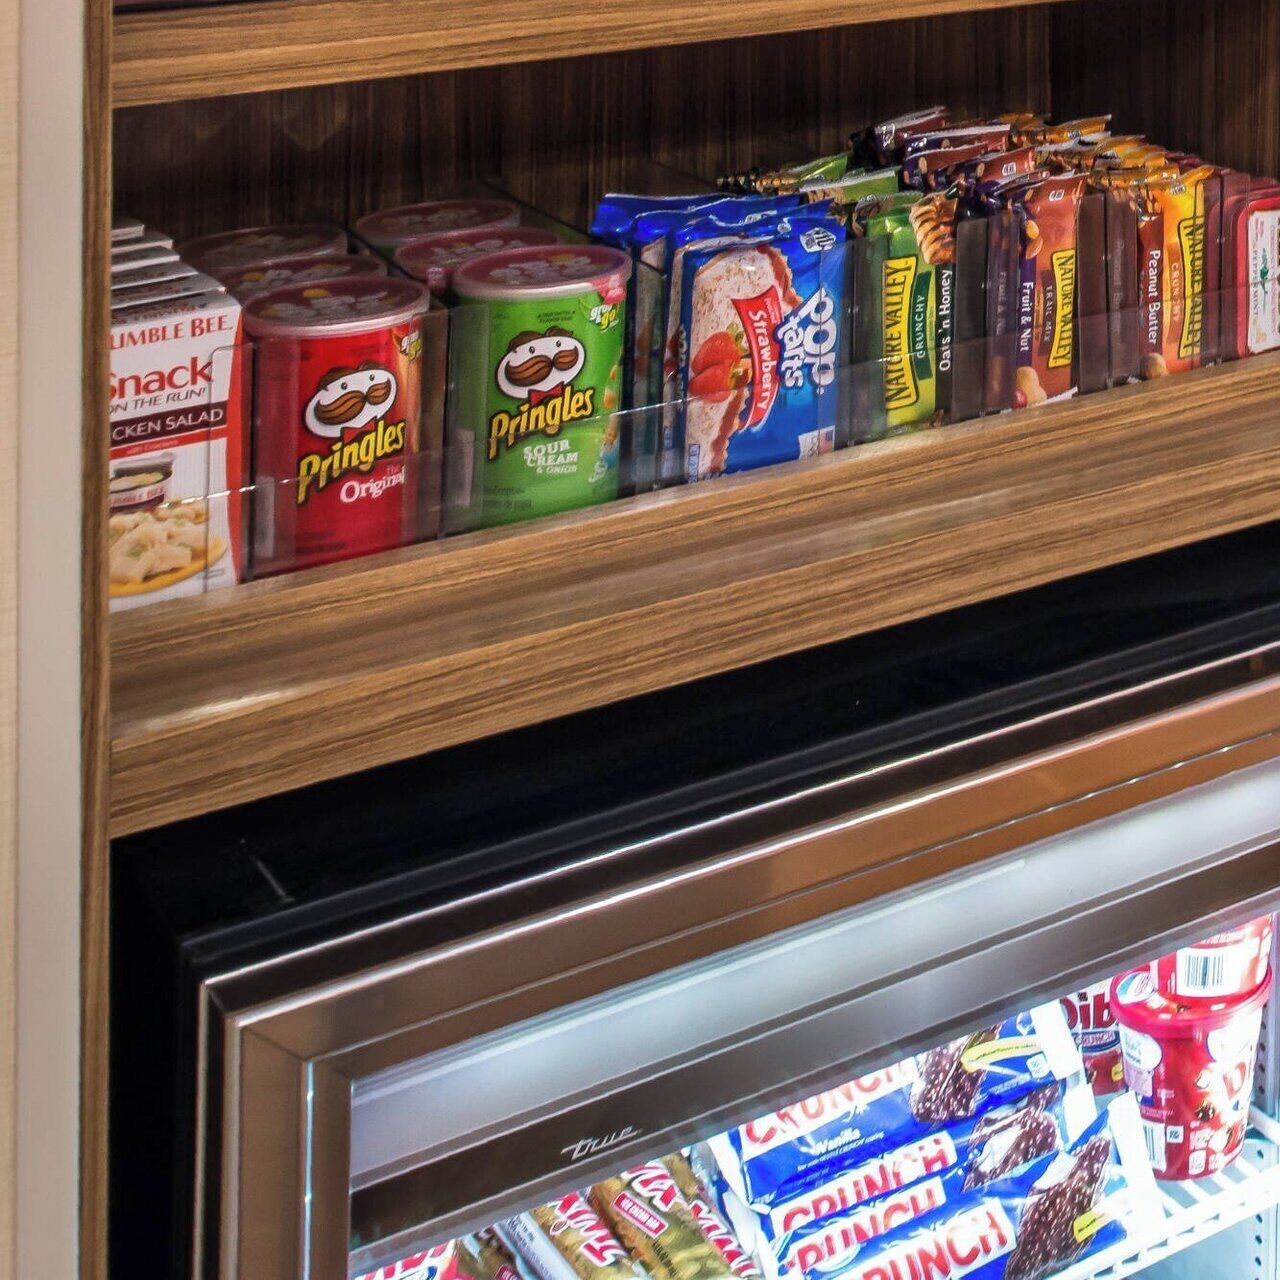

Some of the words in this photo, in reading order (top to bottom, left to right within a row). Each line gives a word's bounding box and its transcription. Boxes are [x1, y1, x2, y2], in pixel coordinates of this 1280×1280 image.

[883, 260, 913, 329] VALLEY
[939, 269, 953, 317] Honey
[1148, 249, 1161, 298] Peanut
[1022, 282, 1034, 315] Fruit
[110, 321, 185, 351] UMBLE
[190, 314, 228, 338] BEE
[916, 294, 926, 359] CRUNCHY
[1020, 325, 1033, 351] Nut
[1148, 301, 1161, 346] Butter
[749, 309, 779, 411] Strawberry
[883, 326, 912, 401] NATURE
[939, 334, 950, 372] Oats
[132, 394, 162, 408] THE
[488, 385, 595, 461] Pringles
[112, 420, 161, 441] CKEN
[166, 408, 224, 431] SALAD
[297, 420, 406, 505] Pringles
[523, 439, 570, 457] SOUR
[546, 464, 578, 475] ONION
